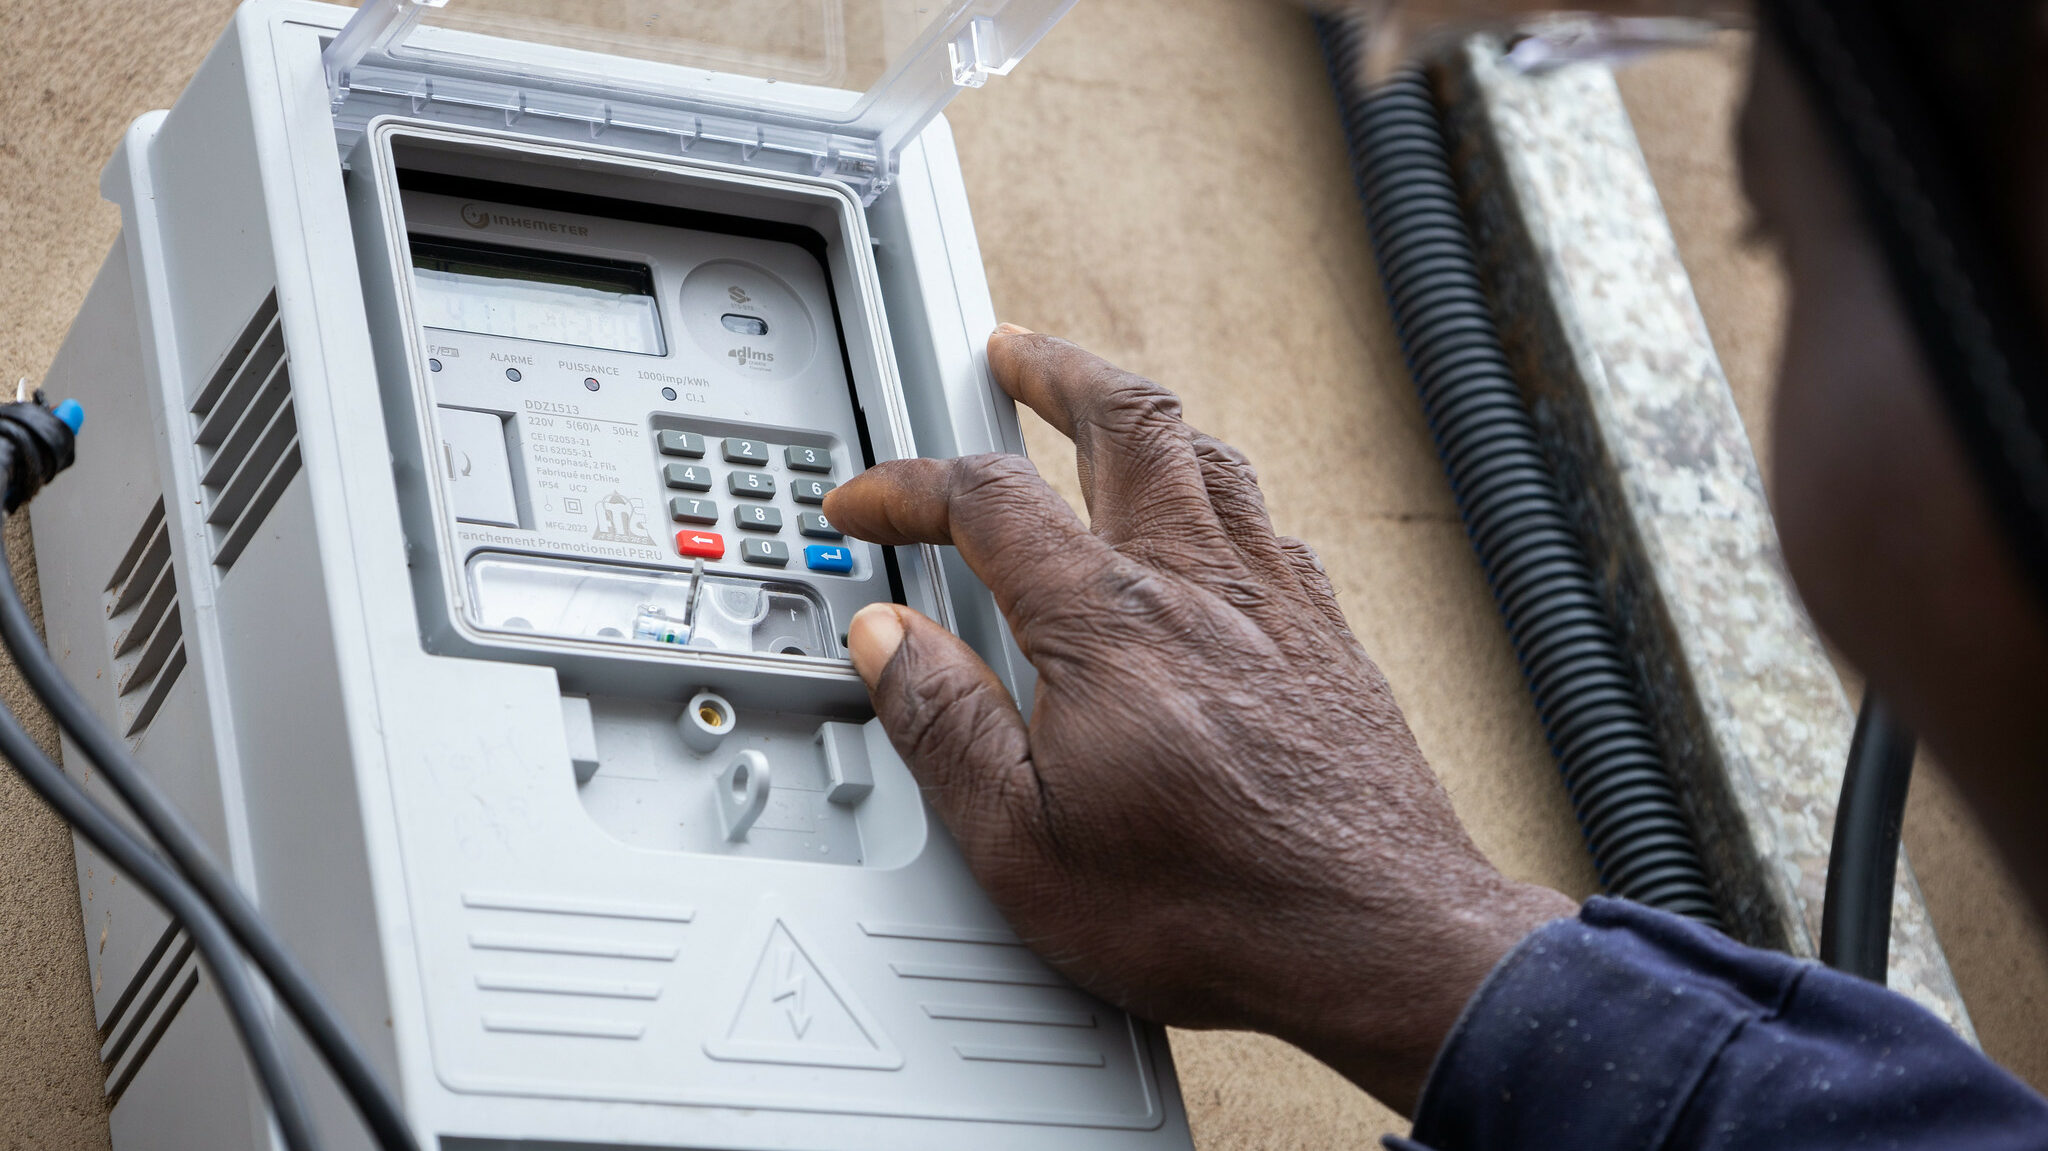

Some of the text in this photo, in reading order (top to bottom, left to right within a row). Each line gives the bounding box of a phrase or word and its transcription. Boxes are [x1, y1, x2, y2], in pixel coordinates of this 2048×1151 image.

[489, 352, 534, 366] ALARME
[558, 360, 620, 377] PUISSANCE
[637, 370, 710, 388] 1000imp/kWh
[525, 400, 580, 415] DDZ1513
[527, 416, 640, 438] 220V 5(60)A 50Hz
[530, 432, 591, 447] CEI 62053-21
[532, 444, 593, 459] CEI 62055-31
[679, 434, 816, 463] 1 2 3
[593, 461, 600, 470] 2
[592, 473, 620, 484] Chine
[684, 467, 822, 496] 4 5 6
[538, 480, 588, 493] IP54 UC2
[689, 500, 829, 528] 7 8 9
[545, 521, 588, 534] MFG.2023
[458, 531, 536, 548] ranchement
[538, 537, 628, 557] Promotionnel
[628, 547, 663, 561] PERU
[761, 541, 772, 555] 0
